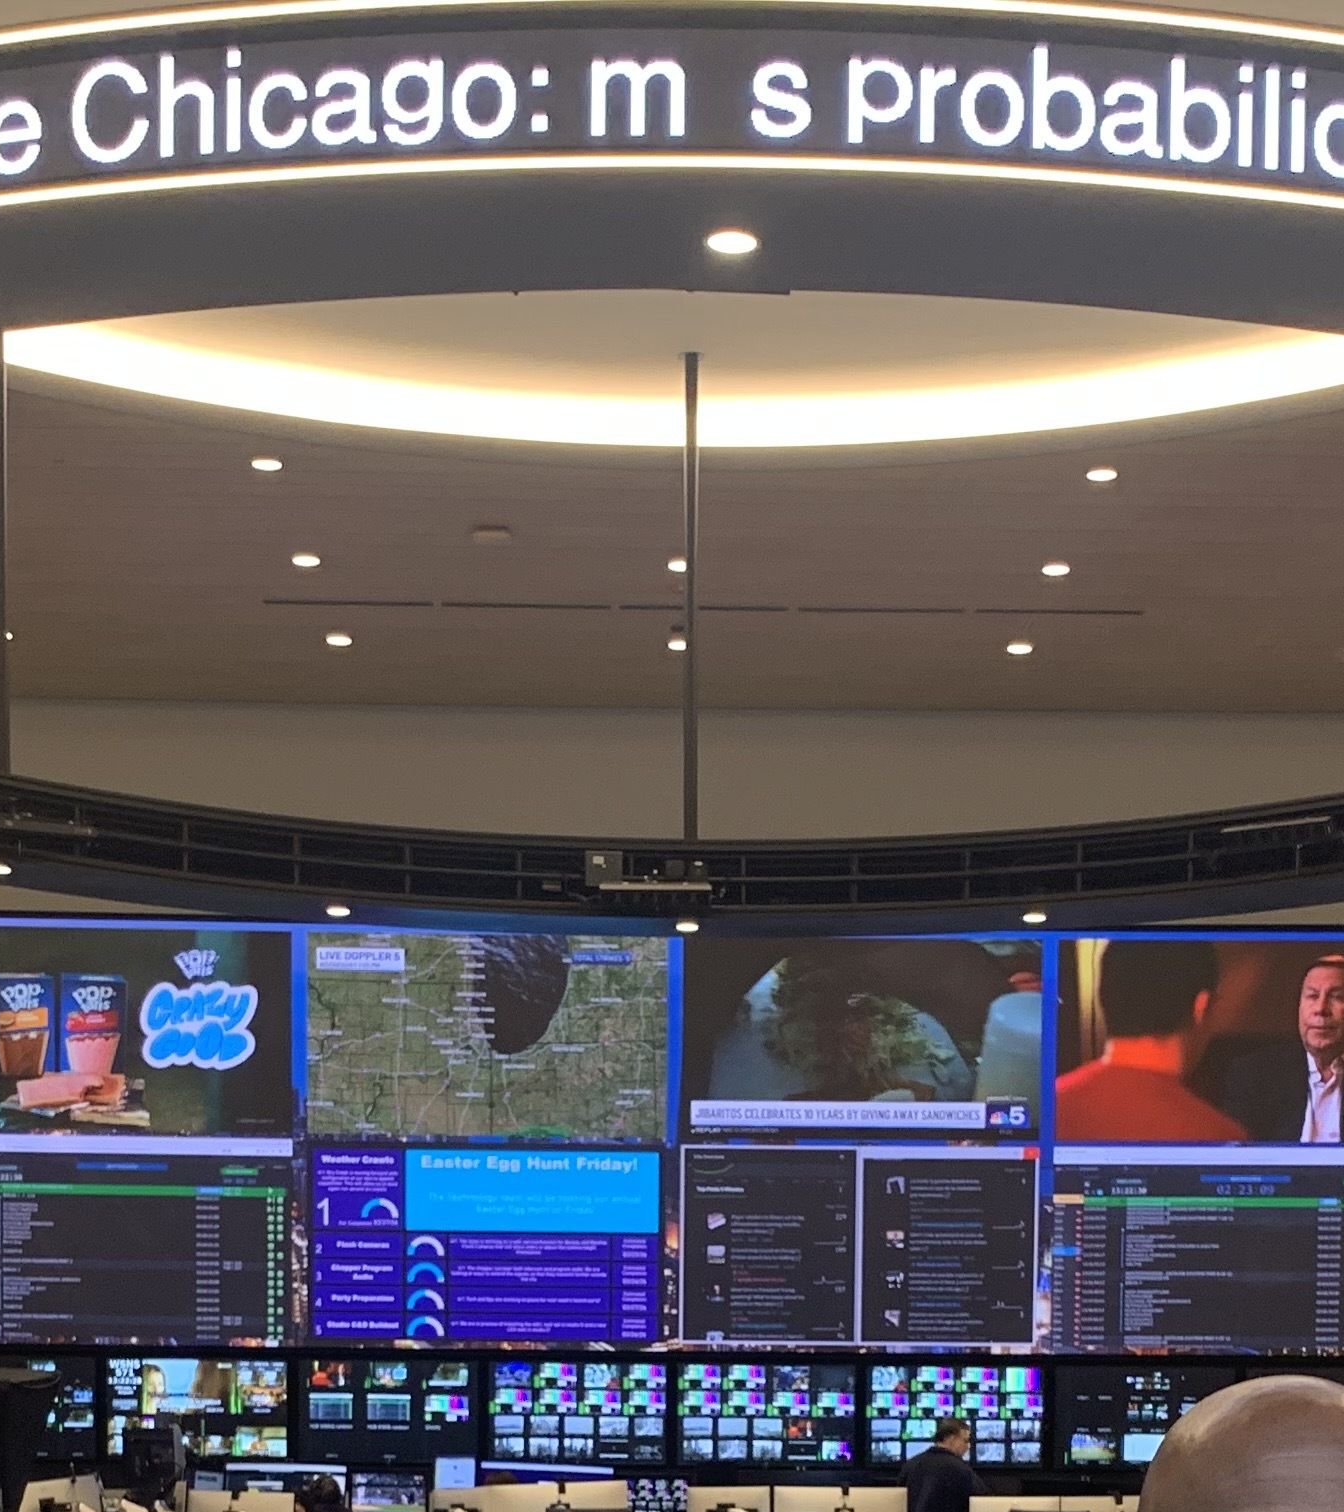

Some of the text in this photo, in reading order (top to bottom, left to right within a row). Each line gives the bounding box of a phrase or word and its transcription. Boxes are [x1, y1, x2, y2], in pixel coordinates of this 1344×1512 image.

[70, 47, 550, 165] Chicago:
[589, 57, 686, 138] m
[749, 60, 812, 140] s
[319, 951, 342, 961] LIVE
[344, 951, 392, 961] DOPPLER
[695, 1107, 981, 1121] JIBARITOS CELEBRATES 10 YEARS BY GIVING AWAY SANDWICHES
[1008, 1105, 1026, 1125] 5
[420, 1154, 639, 1174] Easter Egg Hunt Friday!
[316, 1197, 330, 1226] 1
[109, 1359, 140, 1369] WSNS
